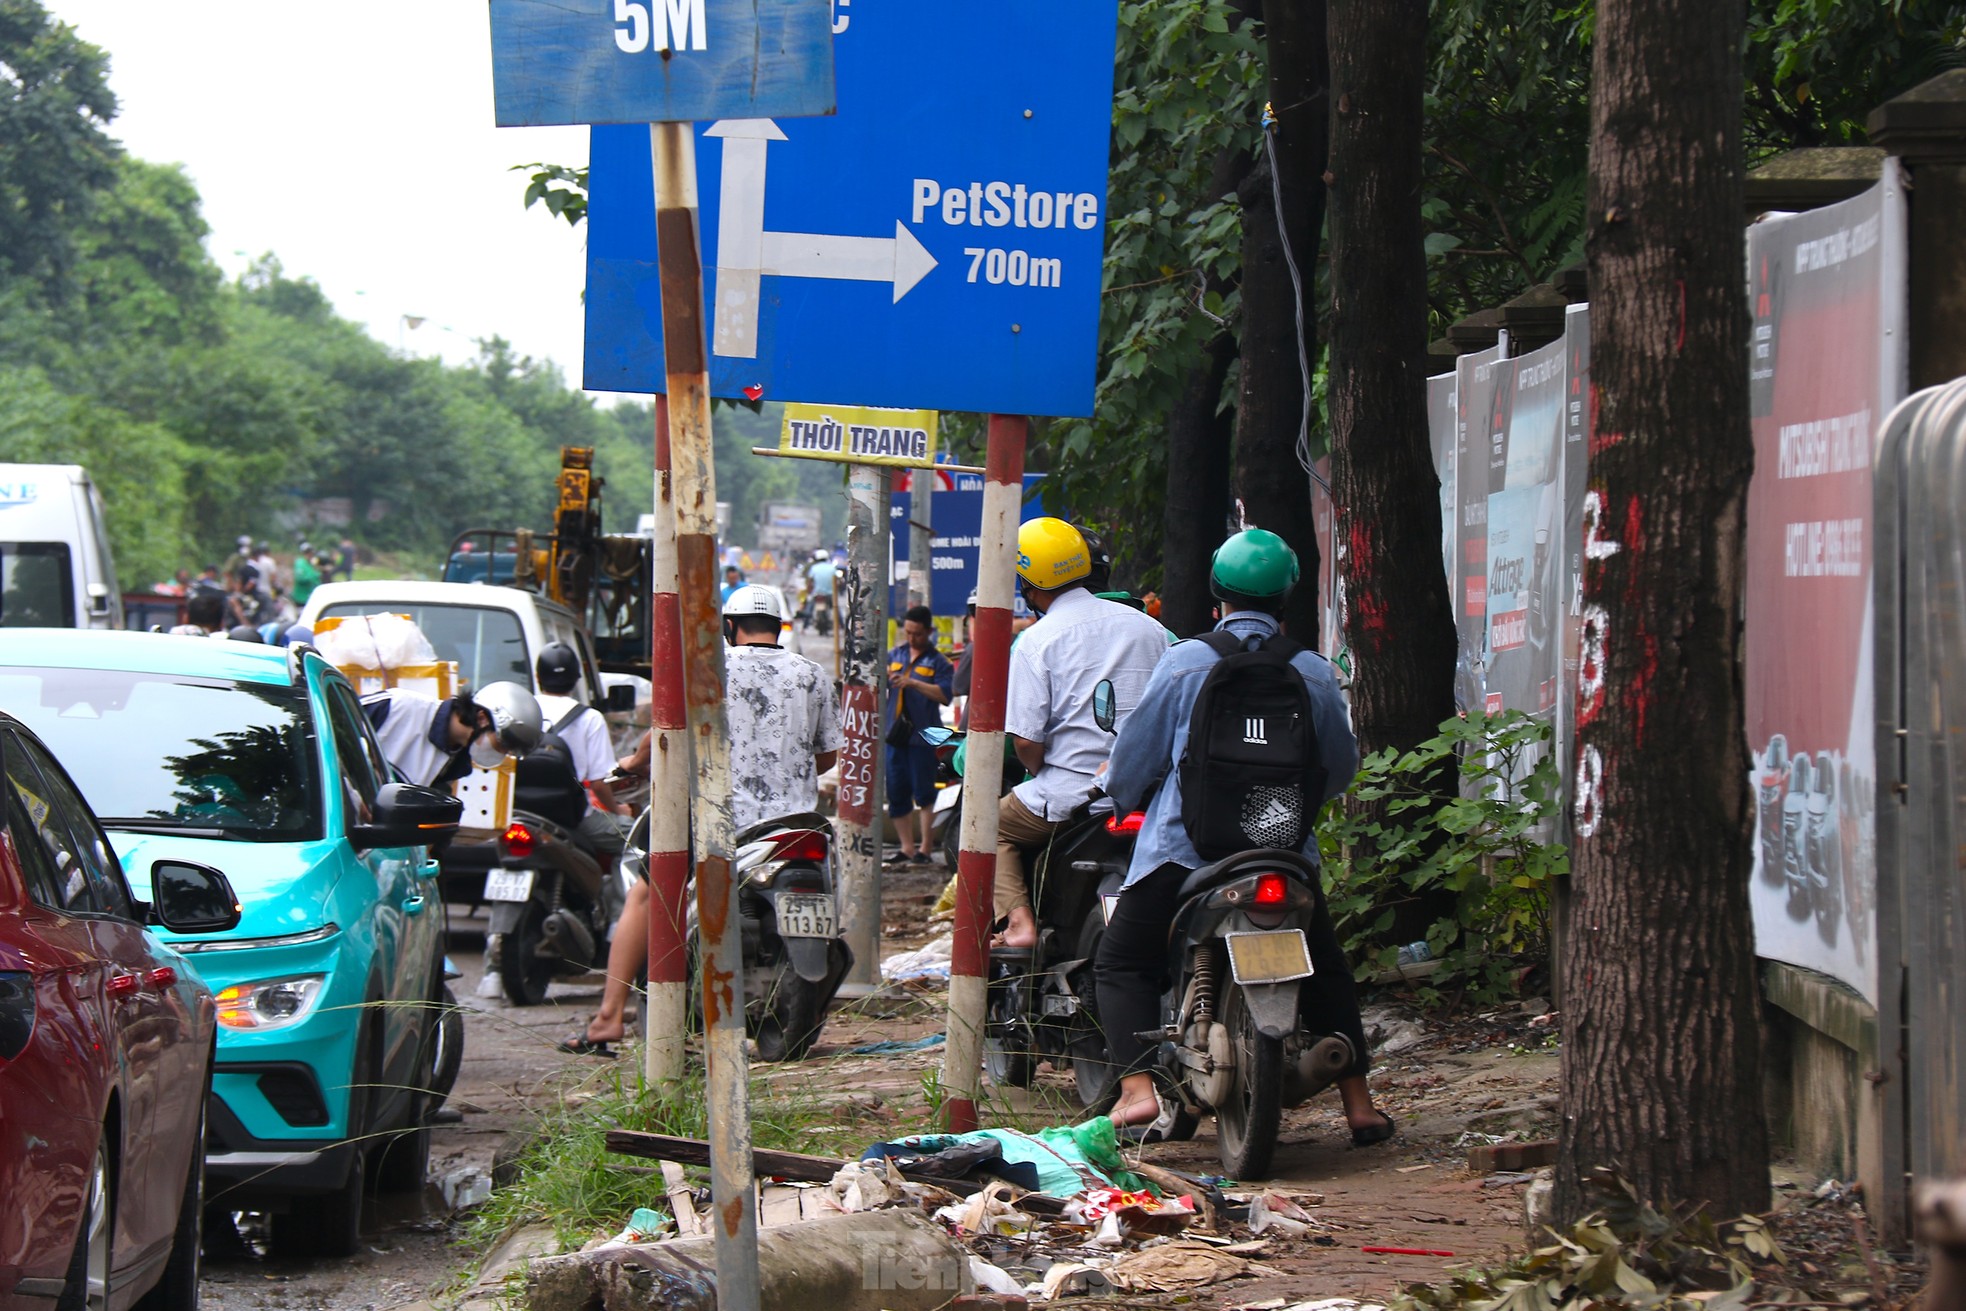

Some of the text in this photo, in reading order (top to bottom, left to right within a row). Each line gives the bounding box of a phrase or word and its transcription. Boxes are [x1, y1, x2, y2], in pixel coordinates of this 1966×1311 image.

[614, 0, 708, 54] 5M
[911, 178, 1099, 230] PetStore
[963, 247, 1062, 288] 700m
[790, 415, 928, 459] THỜI TRANG
[932, 557, 964, 570] 500m
[1489, 556, 1525, 599] Attrage
